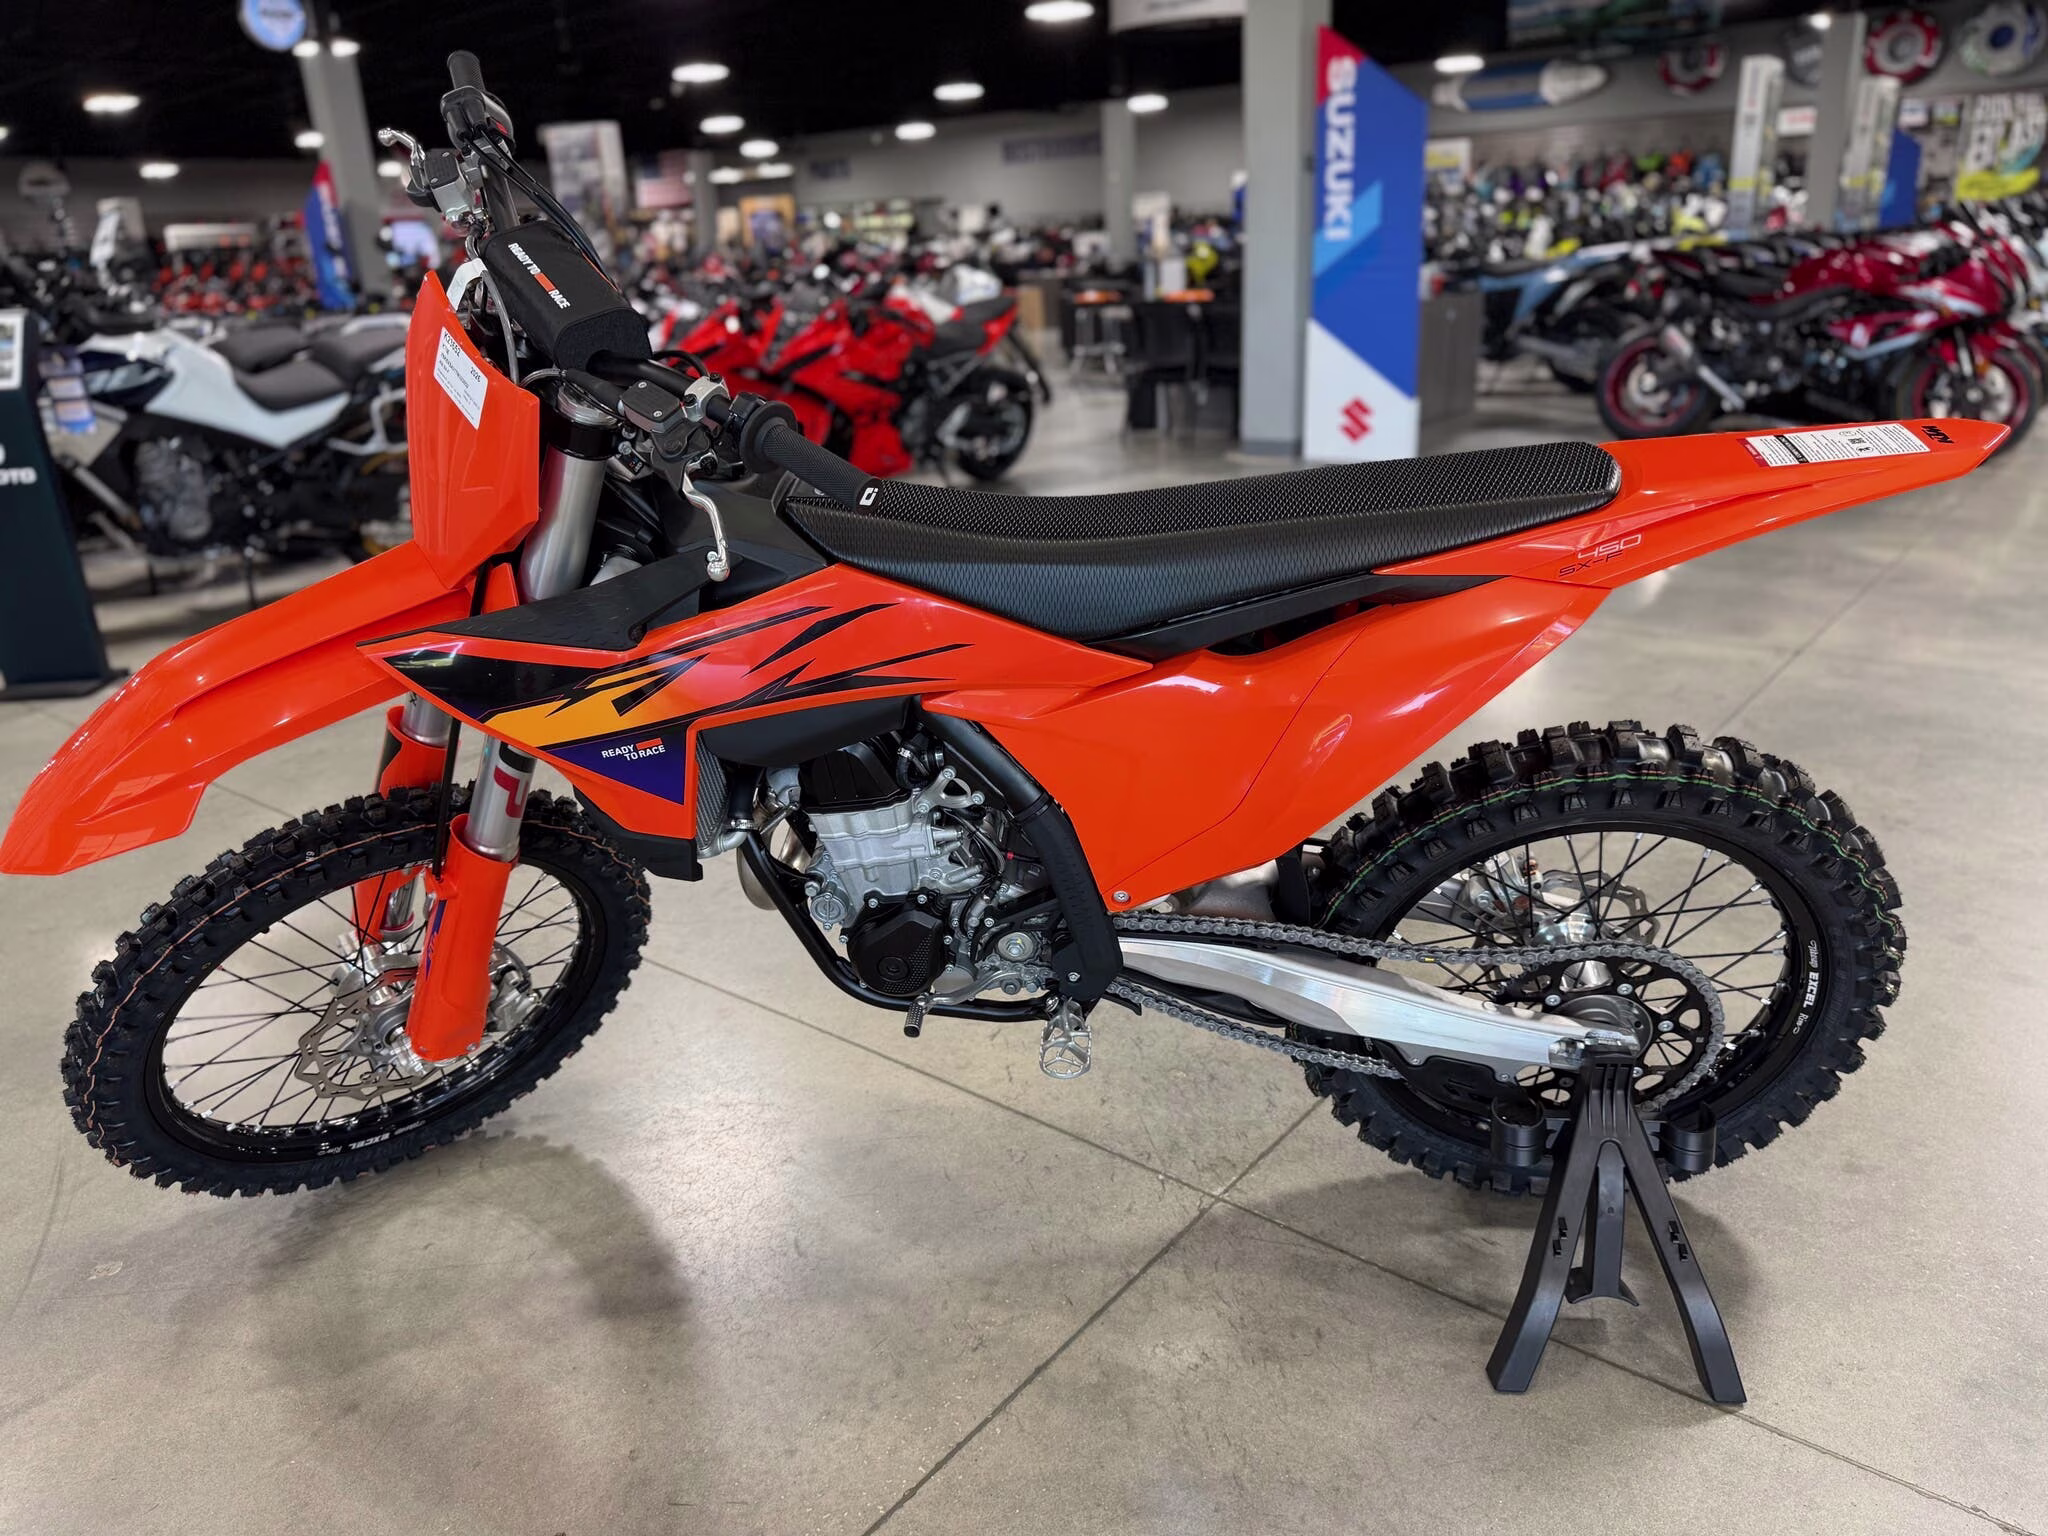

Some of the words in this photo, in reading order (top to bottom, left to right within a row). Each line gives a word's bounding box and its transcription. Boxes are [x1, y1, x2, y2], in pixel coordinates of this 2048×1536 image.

[1325, 54, 1358, 241] SUZUKI
[508, 243, 534, 265] READY
[527, 263, 541, 275] TO
[548, 289, 571, 309] RACE
[1578, 533, 1642, 559] 450
[1559, 550, 1624, 577] SX-F
[601, 744, 634, 758] READY
[624, 751, 639, 761] TO
[638, 744, 666, 758] RACE
[1803, 971, 1820, 1008] EXCEL
[348, 1132, 391, 1150] EXCEL
